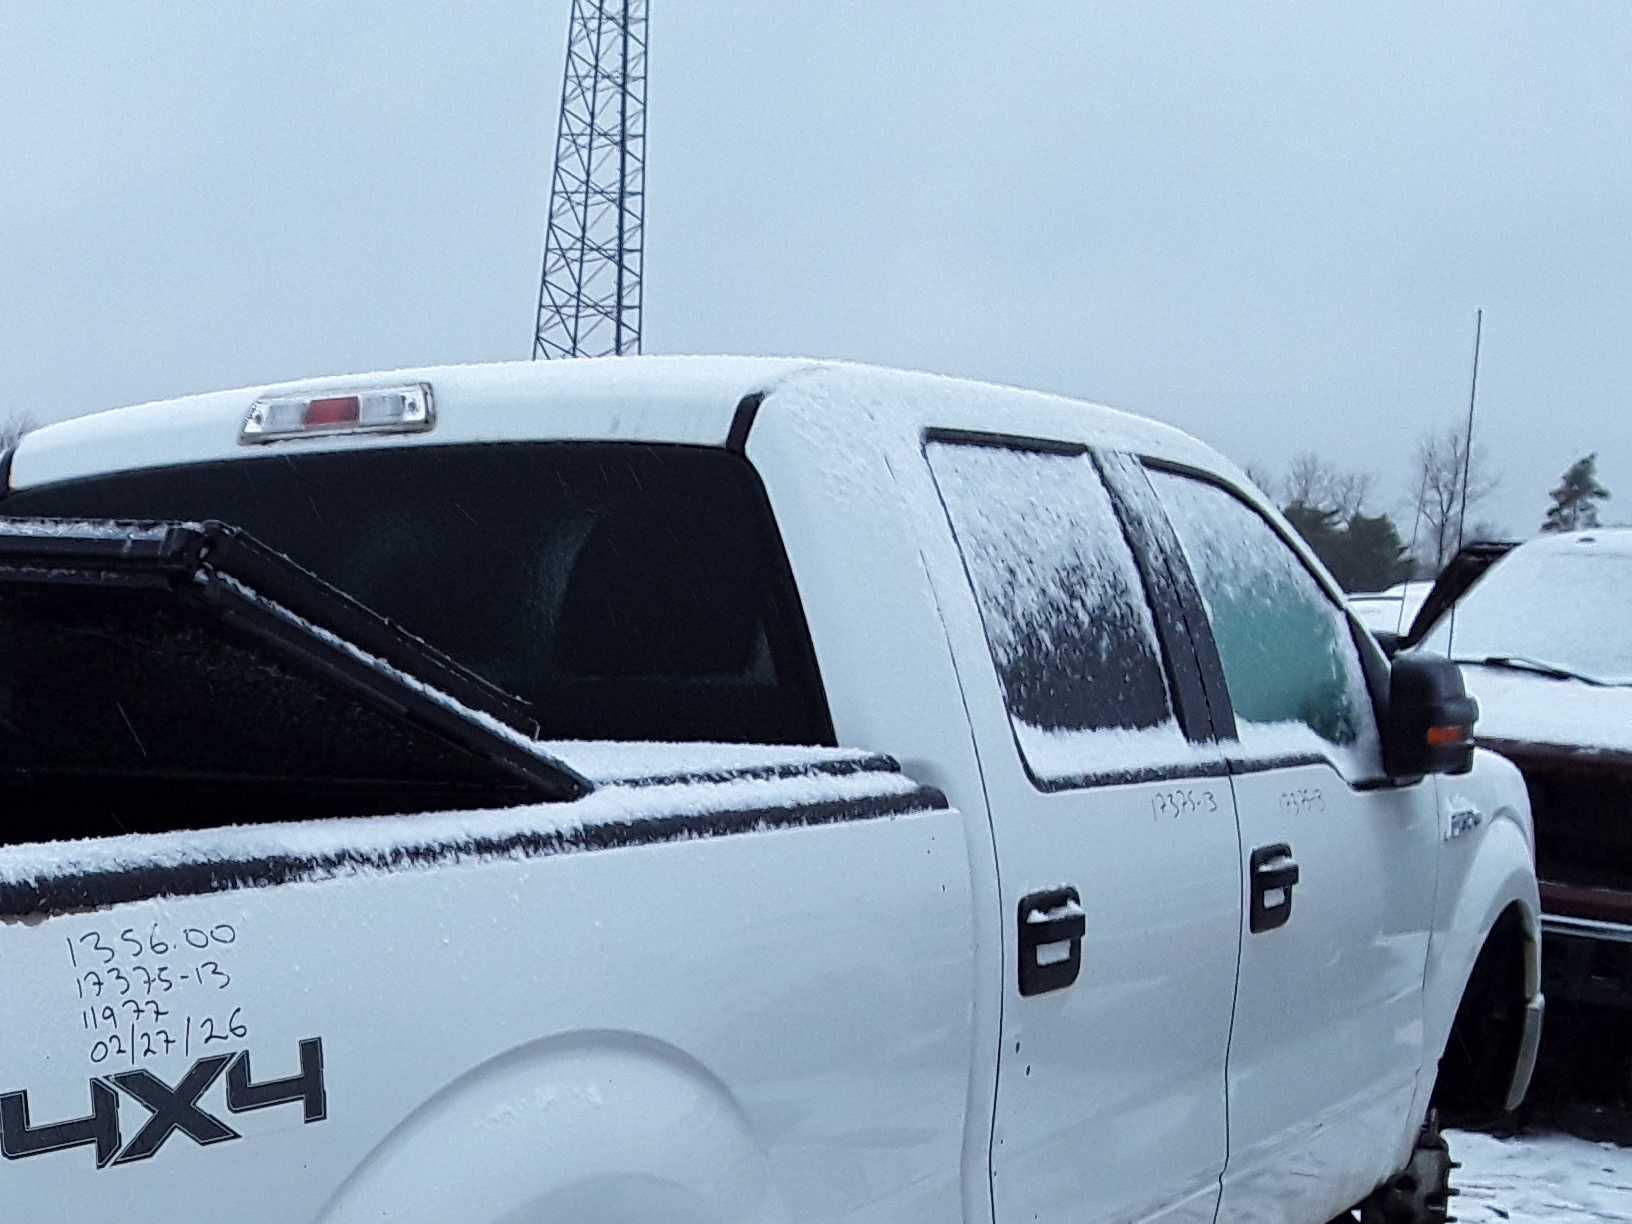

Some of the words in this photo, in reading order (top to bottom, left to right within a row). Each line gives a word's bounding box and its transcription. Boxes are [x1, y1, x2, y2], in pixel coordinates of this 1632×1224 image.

[67, 922, 236, 966] 1356.00
[77, 961, 231, 999] 17375-13
[82, 999, 169, 1030] 11977
[89, 1007, 249, 1065] 02/27/26
